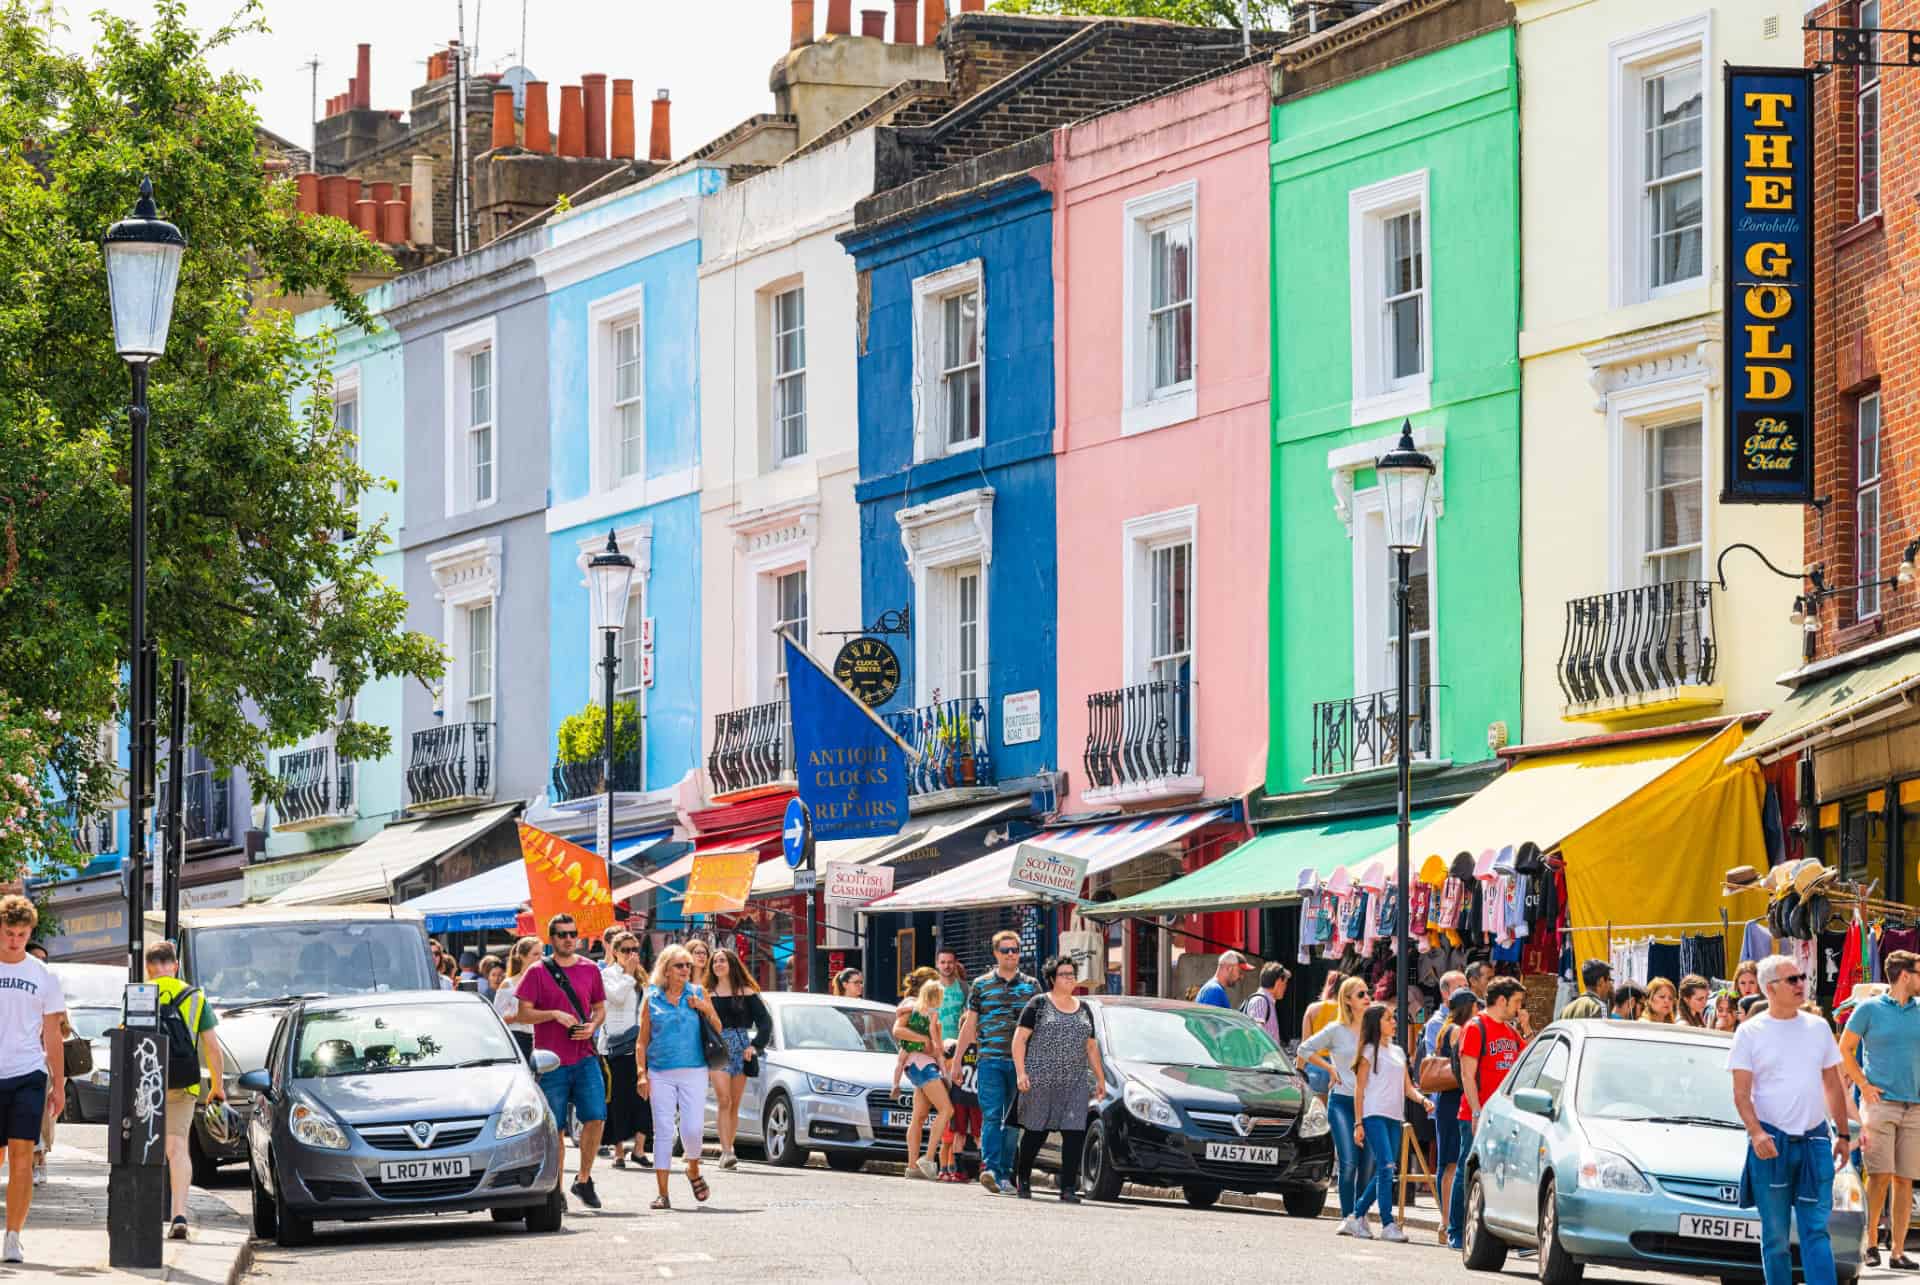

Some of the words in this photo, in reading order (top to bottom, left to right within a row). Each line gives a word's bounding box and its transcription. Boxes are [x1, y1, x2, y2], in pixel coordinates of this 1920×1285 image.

[1744, 92, 1793, 210] THE
[1736, 215, 1800, 233] Portobello
[1744, 241, 1792, 400] GOLD
[1754, 417, 1789, 434] Pub
[1780, 434, 1799, 451] &
[855, 659, 880, 667] CLOCK
[808, 745, 887, 766] ANTIQUE
[815, 767, 888, 787] CLOCKS
[847, 787, 860, 801] &
[815, 799, 897, 819] REPAIRS
[1025, 856, 1076, 878] SCOTTISH
[835, 872, 883, 887] SCOTTISH
[1018, 867, 1076, 890] CASHMERE
[831, 884, 885, 898] CASHMERE
[0, 977, 38, 995] HARTT
[1213, 1145, 1246, 1160] VA57
[1250, 1147, 1273, 1162] VAK
[387, 1163, 427, 1179] LR07
[432, 1160, 463, 1177] MVD
[1691, 1217, 1729, 1237] YR51
